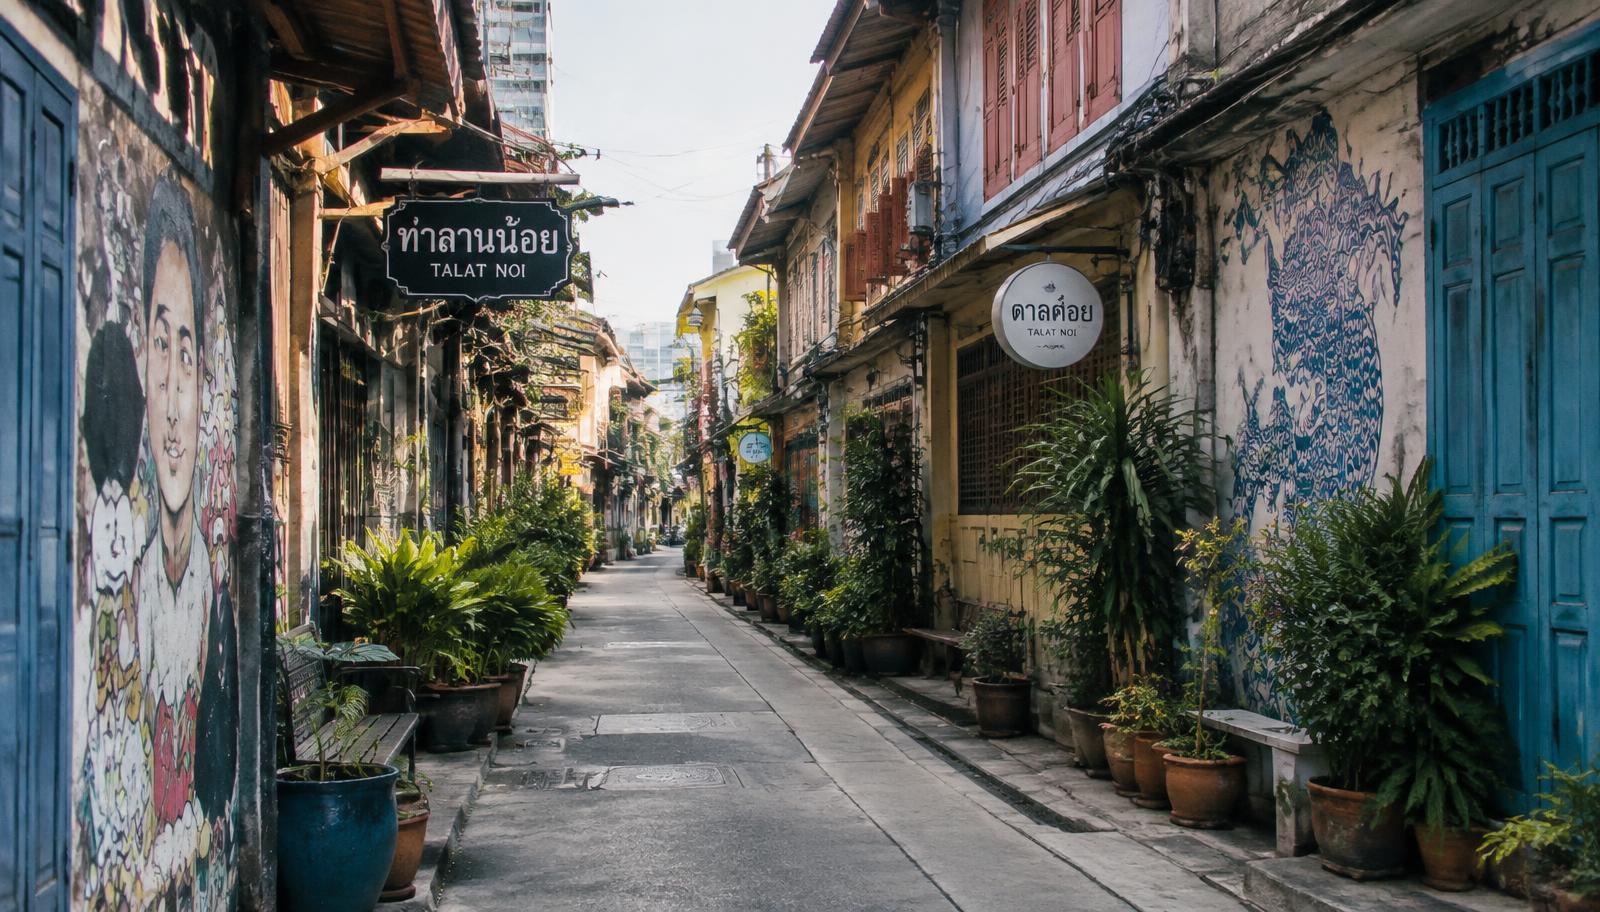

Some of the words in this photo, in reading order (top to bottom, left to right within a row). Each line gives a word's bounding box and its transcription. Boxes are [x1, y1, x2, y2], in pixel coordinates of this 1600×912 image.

[397, 216, 558, 254] ท่าลานน้อย
[430, 263, 487, 278] TALAT
[495, 263, 526, 278] NOI
[1027, 328, 1056, 337] TALAT
[1060, 328, 1077, 337] NOI
